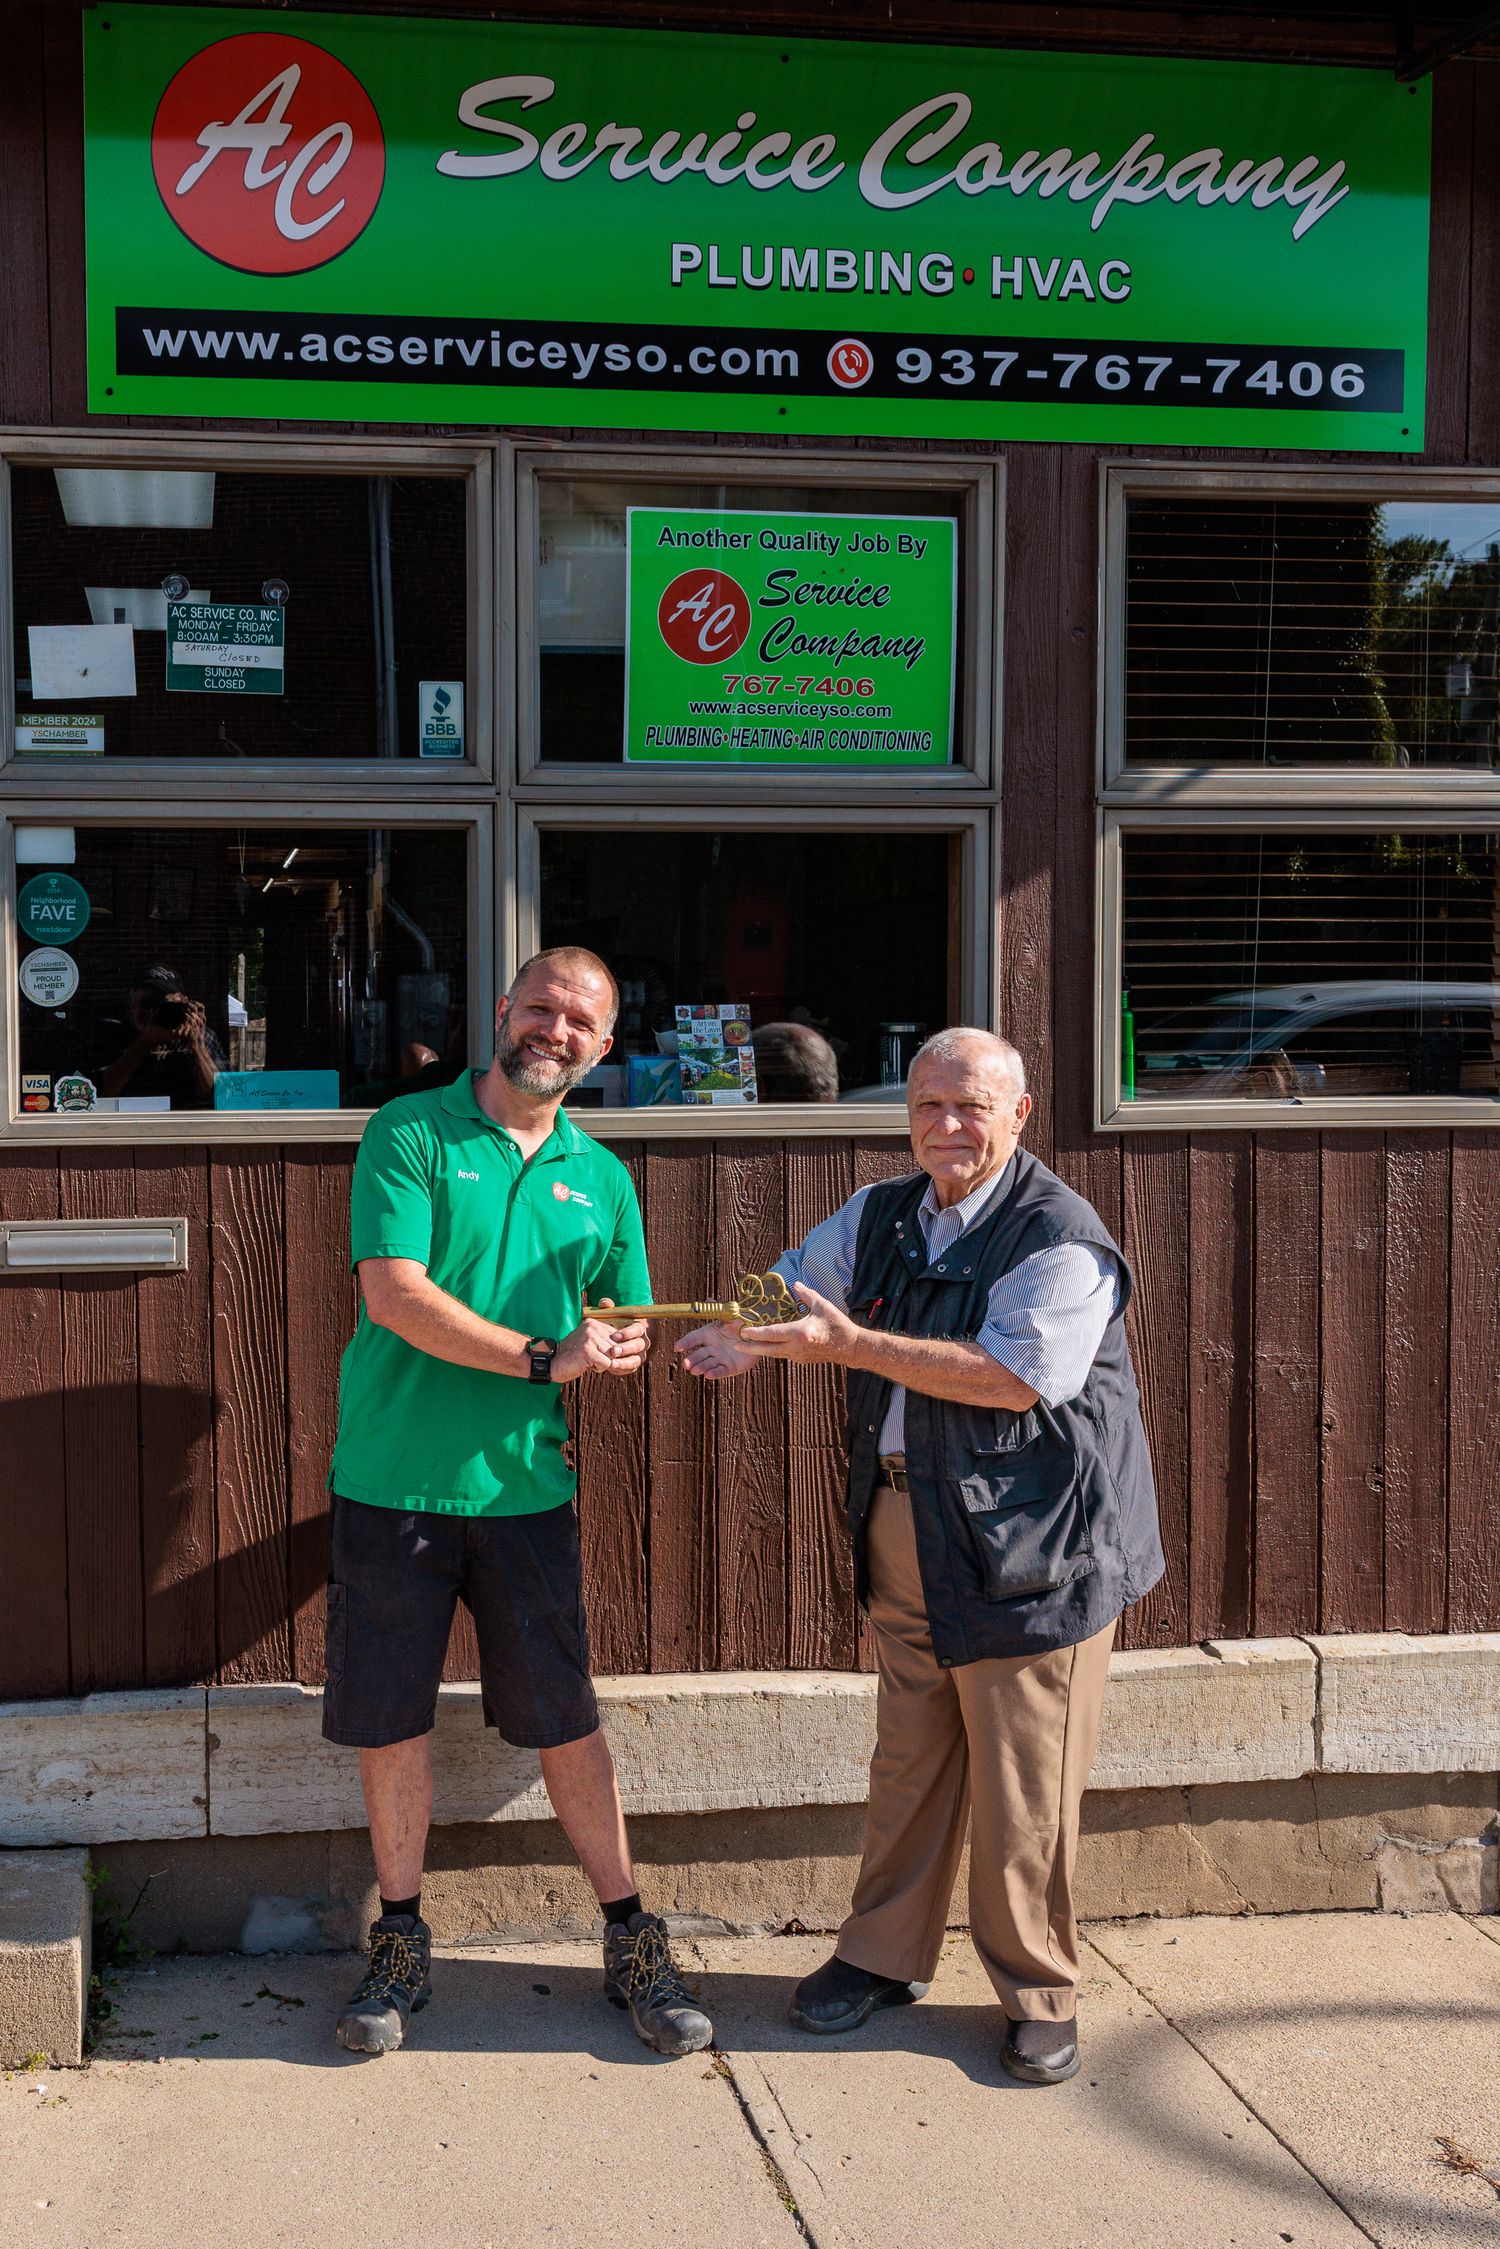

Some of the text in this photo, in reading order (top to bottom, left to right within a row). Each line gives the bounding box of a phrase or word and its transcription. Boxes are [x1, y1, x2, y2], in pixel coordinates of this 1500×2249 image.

[175, 62, 354, 241] AC
[435, 75, 1350, 240] Service Company
[671, 243, 1132, 301] PLUMBING HVAC
[142, 328, 800, 380] www.acserviceyso.com
[896, 347, 1367, 398] 937-767-7406
[657, 526, 928, 559] Another Quality Job By
[758, 568, 891, 608] Service
[171, 606, 280, 621] AC SERVICE CO. INC.
[668, 582, 735, 652] AC
[178, 620, 222, 630] MONDAY
[236, 622, 272, 632] FRIDAY
[177, 631, 219, 641] 8:00AM
[233, 633, 274, 643] 3:30PM
[759, 616, 926, 670] Company
[185, 643, 229, 653] SATURDAY
[204, 667, 245, 677] SUNDAY
[204, 679, 245, 689] CLOSED
[723, 674, 875, 697] 767-7406
[689, 701, 893, 720] www.acserviceyso.com
[22, 716, 96, 726] MEMBER 2024
[32, 730, 86, 738] YSCHAMBER
[425, 723, 456, 735] BBB
[799, 730, 825, 750] AIR
[828, 730, 932, 752] CONDITIONING
[30, 905, 76, 921] FAVE
[33, 982, 66, 991] MEMBER
[36, 975, 62, 983] PROUD
[25, 1080, 49, 1088] VISA
[457, 1169, 480, 1182] Andy
